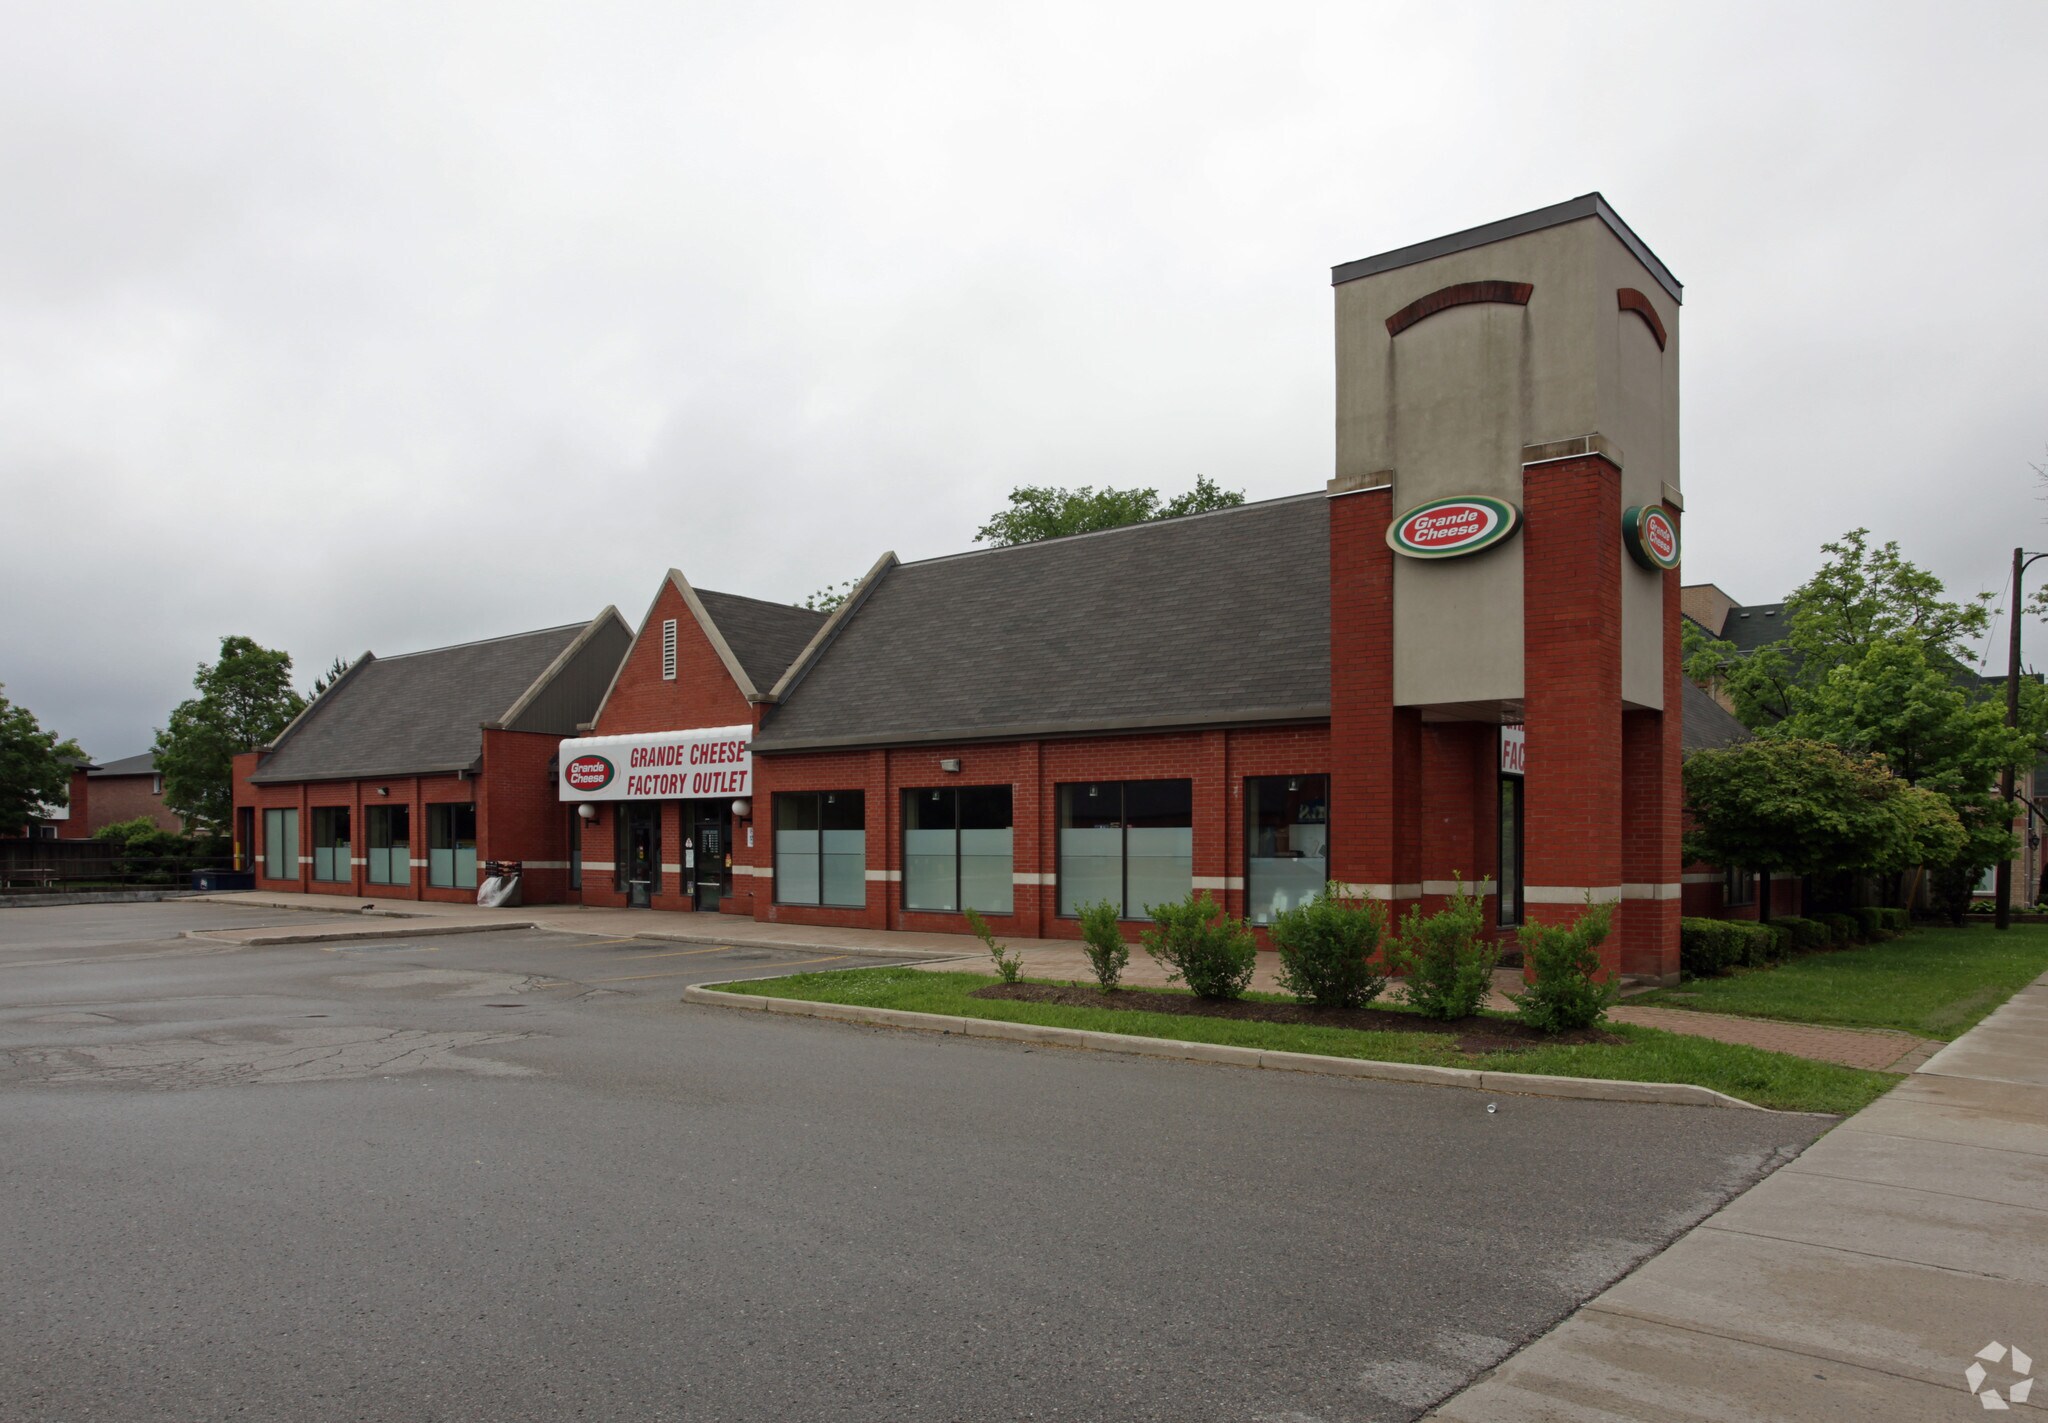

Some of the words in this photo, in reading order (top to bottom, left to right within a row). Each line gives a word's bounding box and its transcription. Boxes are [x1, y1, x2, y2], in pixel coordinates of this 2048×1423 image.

[1414, 510, 1478, 530] Grande
[1650, 519, 1670, 541] Grande
[1414, 524, 1479, 541] Cheese
[1650, 531, 1670, 553] Cheese
[630, 745, 684, 768] GRANDE
[690, 740, 746, 763] CHEESE
[570, 773, 605, 783] Cheese
[571, 762, 605, 773] Grande
[627, 773, 687, 795] FACTORY
[692, 770, 748, 793] OUTLET
